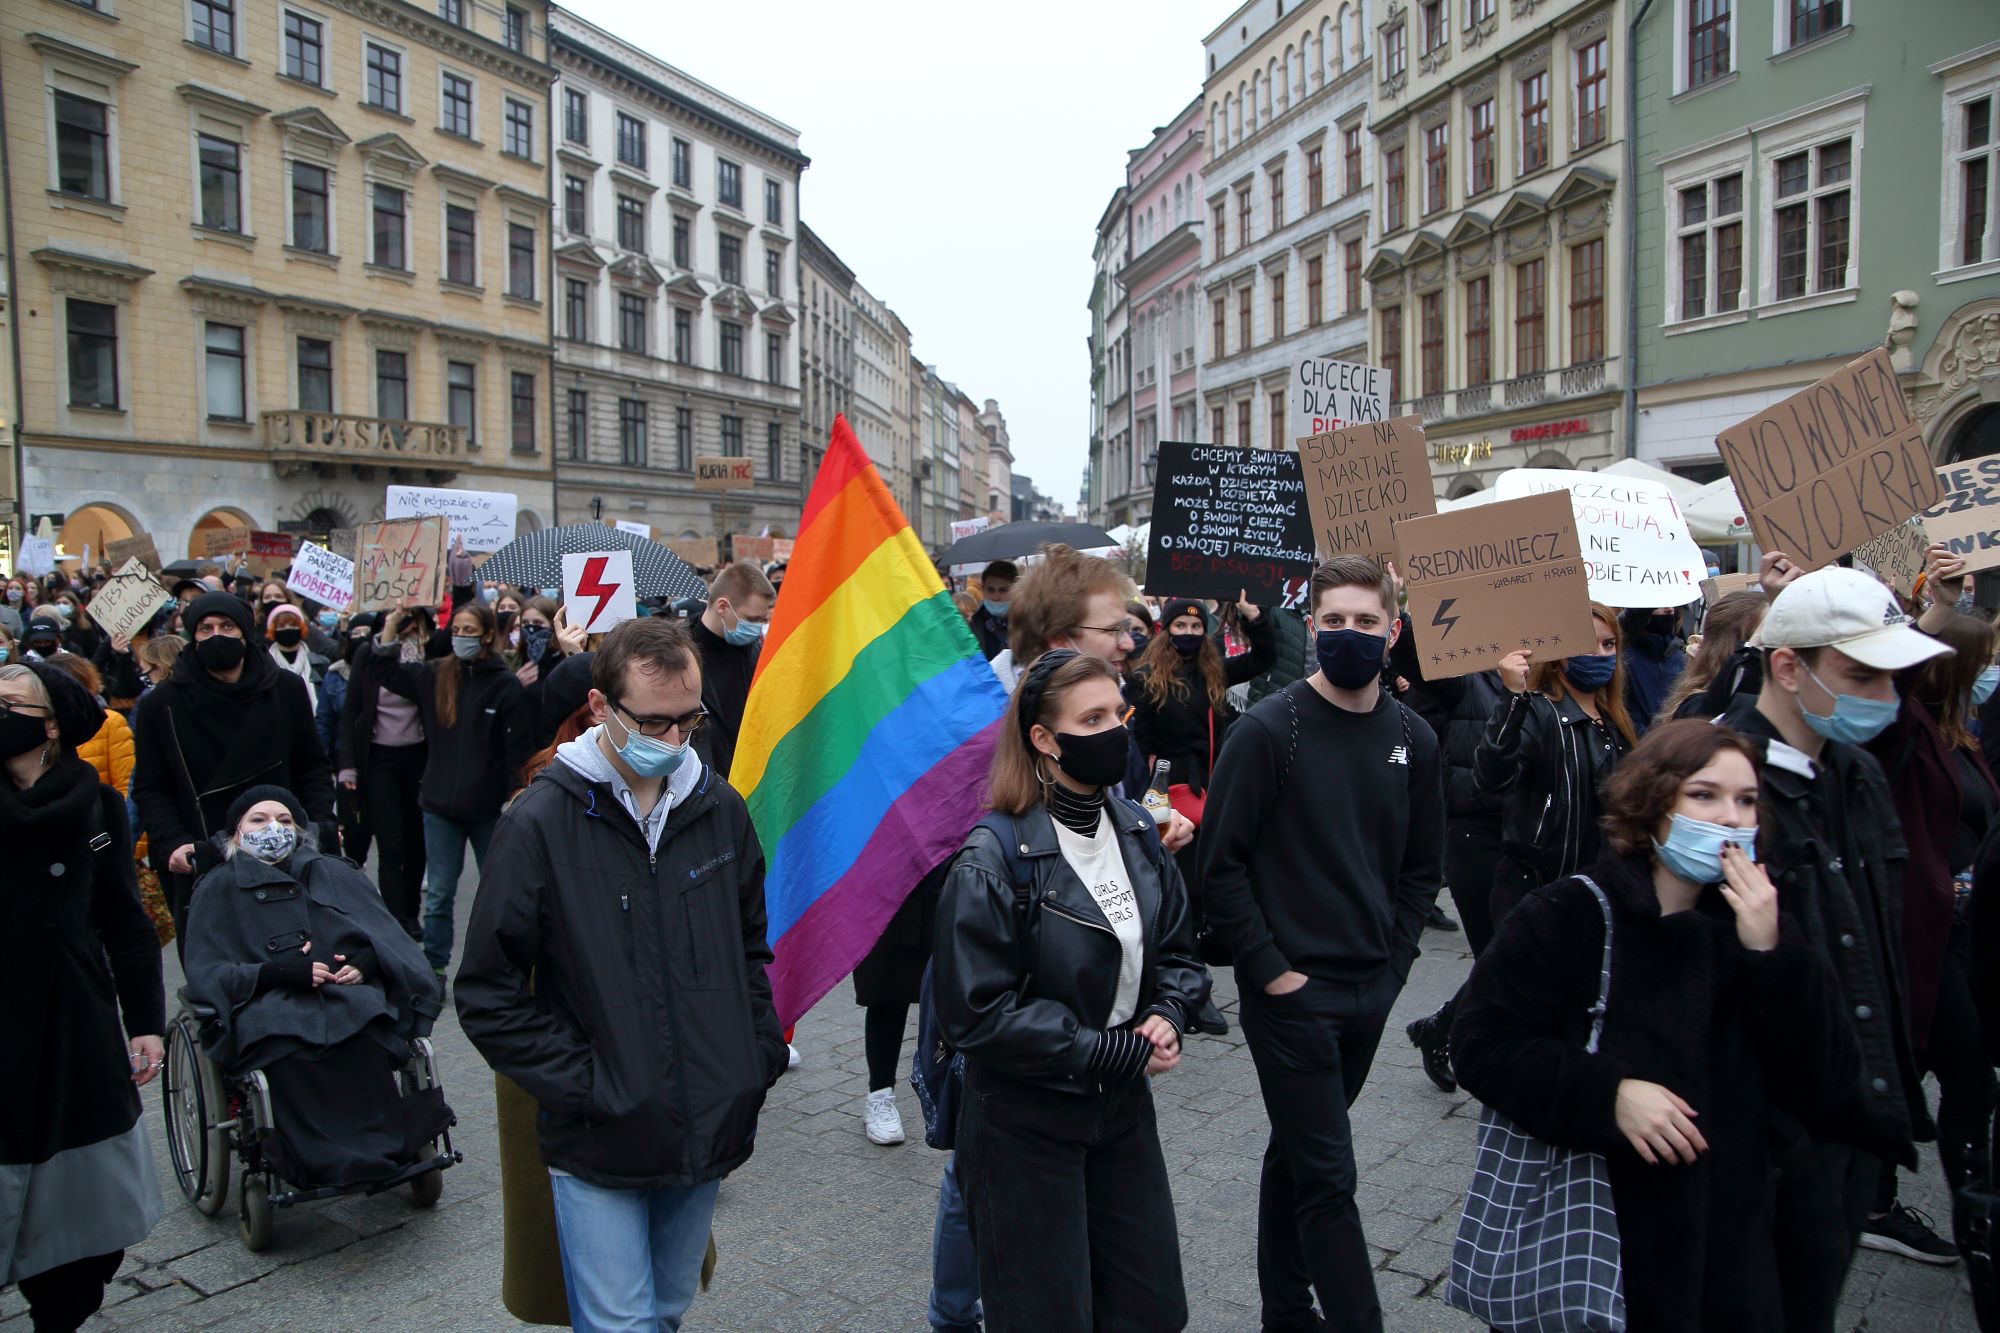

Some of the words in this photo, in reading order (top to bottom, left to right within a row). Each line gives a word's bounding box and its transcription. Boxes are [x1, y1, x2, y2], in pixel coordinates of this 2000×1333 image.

[1300, 360, 1379, 396] CHCECIE
[1303, 389, 1337, 417] DLA
[1350, 395, 1381, 422] NAS
[1307, 432, 1357, 464] 500+
[1373, 423, 1399, 446] NA
[1724, 420, 1796, 510] NO
[1789, 358, 1911, 474] WOMEN
[1191, 448, 1244, 463] CHCEMY
[700, 463, 728, 480] KURIA
[1209, 464, 1219, 475] W
[1226, 463, 1277, 477] KTÓRYM
[1318, 450, 1404, 491] MARTWE
[1171, 473, 1211, 486] KAŻDA
[1219, 476, 1304, 493] DZIEWCZYNA
[1220, 488, 1277, 501] KOBIETA
[1174, 496, 1210, 509] MOŻE
[1215, 500, 1296, 516] DECYDOWAĆ
[1324, 478, 1407, 521] DZIECKO
[1763, 479, 1843, 562] NO
[1845, 434, 1939, 536] KRAJ
[1190, 510, 1198, 521] O
[1203, 511, 1242, 524] SWOIM
[1248, 515, 1285, 532] CIELE,
[1188, 523, 1199, 536] O
[1201, 523, 1239, 537] SWOIM
[1243, 527, 1283, 547] ŻYCIU,
[1326, 519, 1373, 554] NAM
[1590, 534, 1621, 552] NIE
[304, 544, 350, 569] ZAJMIJCIE
[363, 547, 421, 572] MAMY
[1160, 536, 1173, 549] O
[1175, 536, 1230, 557] SWOJEJ
[1233, 543, 1313, 563] PRZYSZŁOŚCI.
[1543, 565, 1578, 581] HRABI
[363, 573, 421, 603] DOŚĆ
[1093, 880, 1119, 897] GIRLS
[1108, 907, 1134, 924] GIRLS
